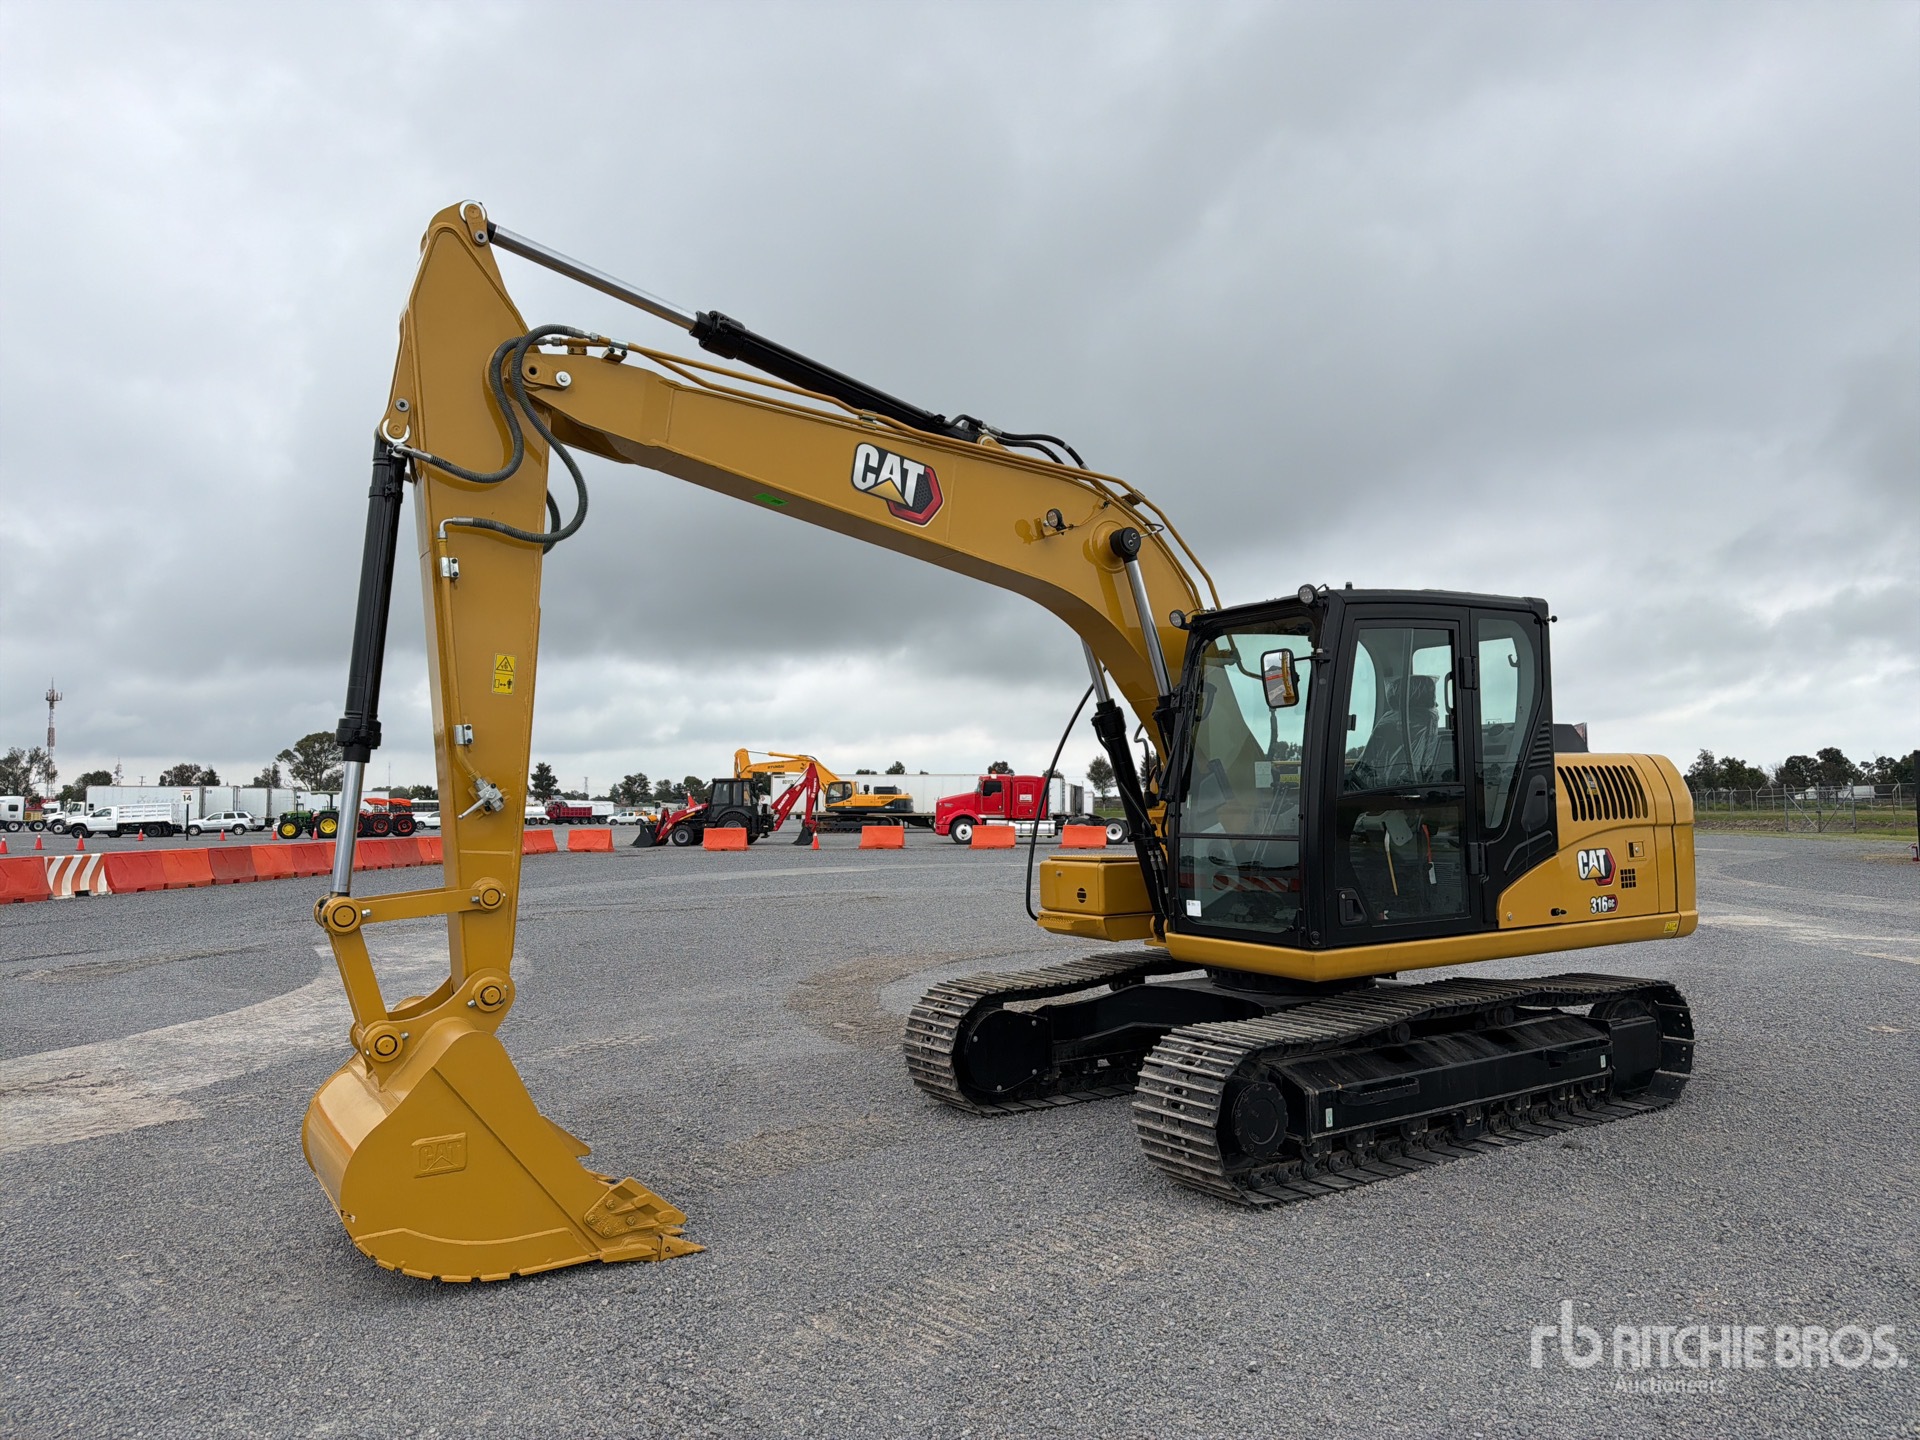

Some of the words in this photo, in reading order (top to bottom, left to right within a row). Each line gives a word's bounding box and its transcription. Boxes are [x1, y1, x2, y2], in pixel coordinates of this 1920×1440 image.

[852, 443, 926, 508] CAT
[183, 794, 192, 802] 14
[1577, 849, 1606, 879] CAT
[1590, 896, 1608, 914] 316
[419, 1140, 463, 1172] CAT
